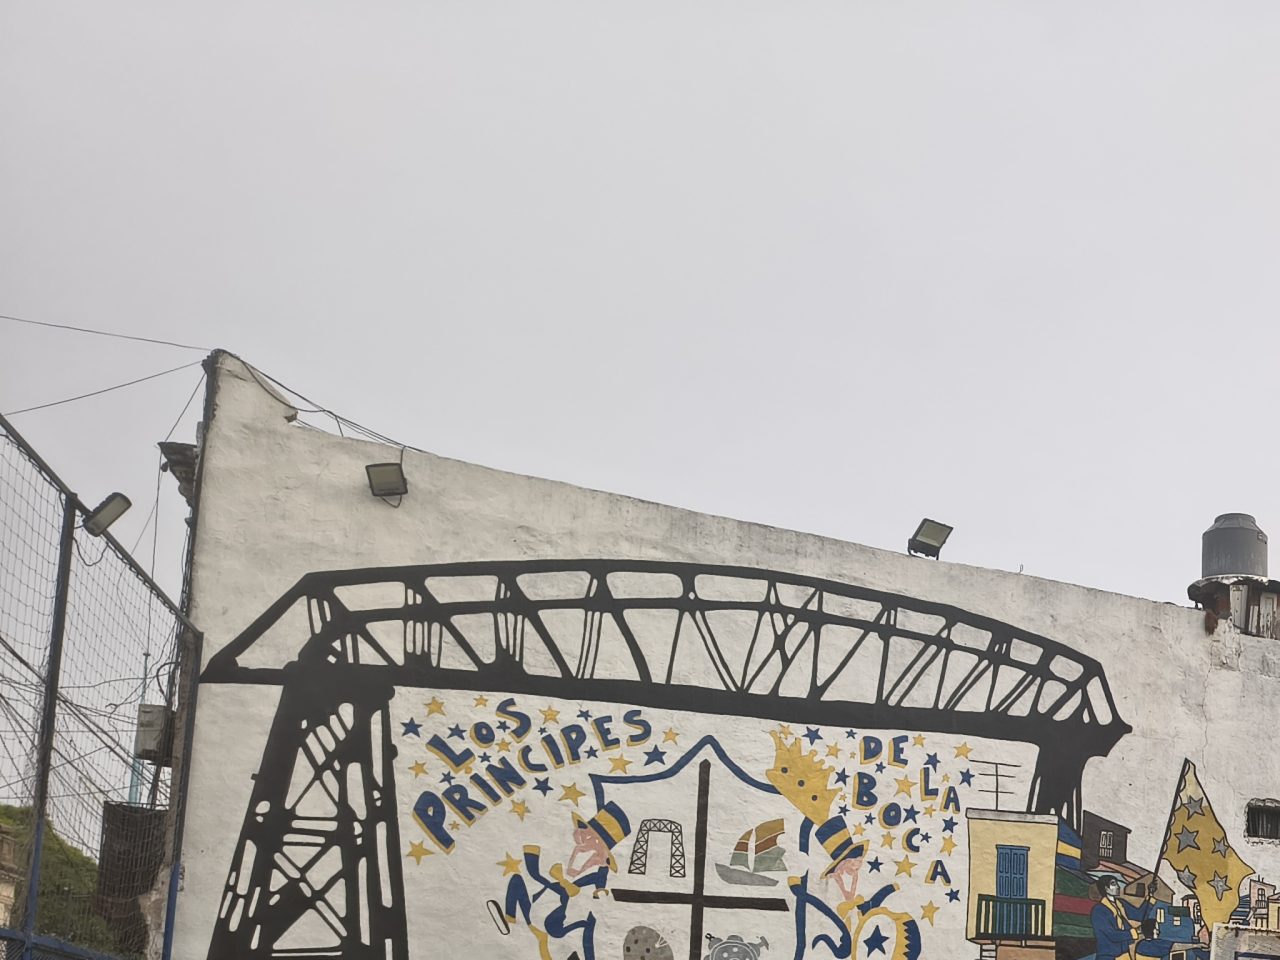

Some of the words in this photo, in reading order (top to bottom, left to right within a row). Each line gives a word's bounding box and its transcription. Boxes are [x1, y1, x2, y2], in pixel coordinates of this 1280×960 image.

[426, 698, 531, 772] LOS
[860, 735, 908, 768] DE
[920, 767, 960, 813] LA
[852, 772, 951, 886] BOCA
